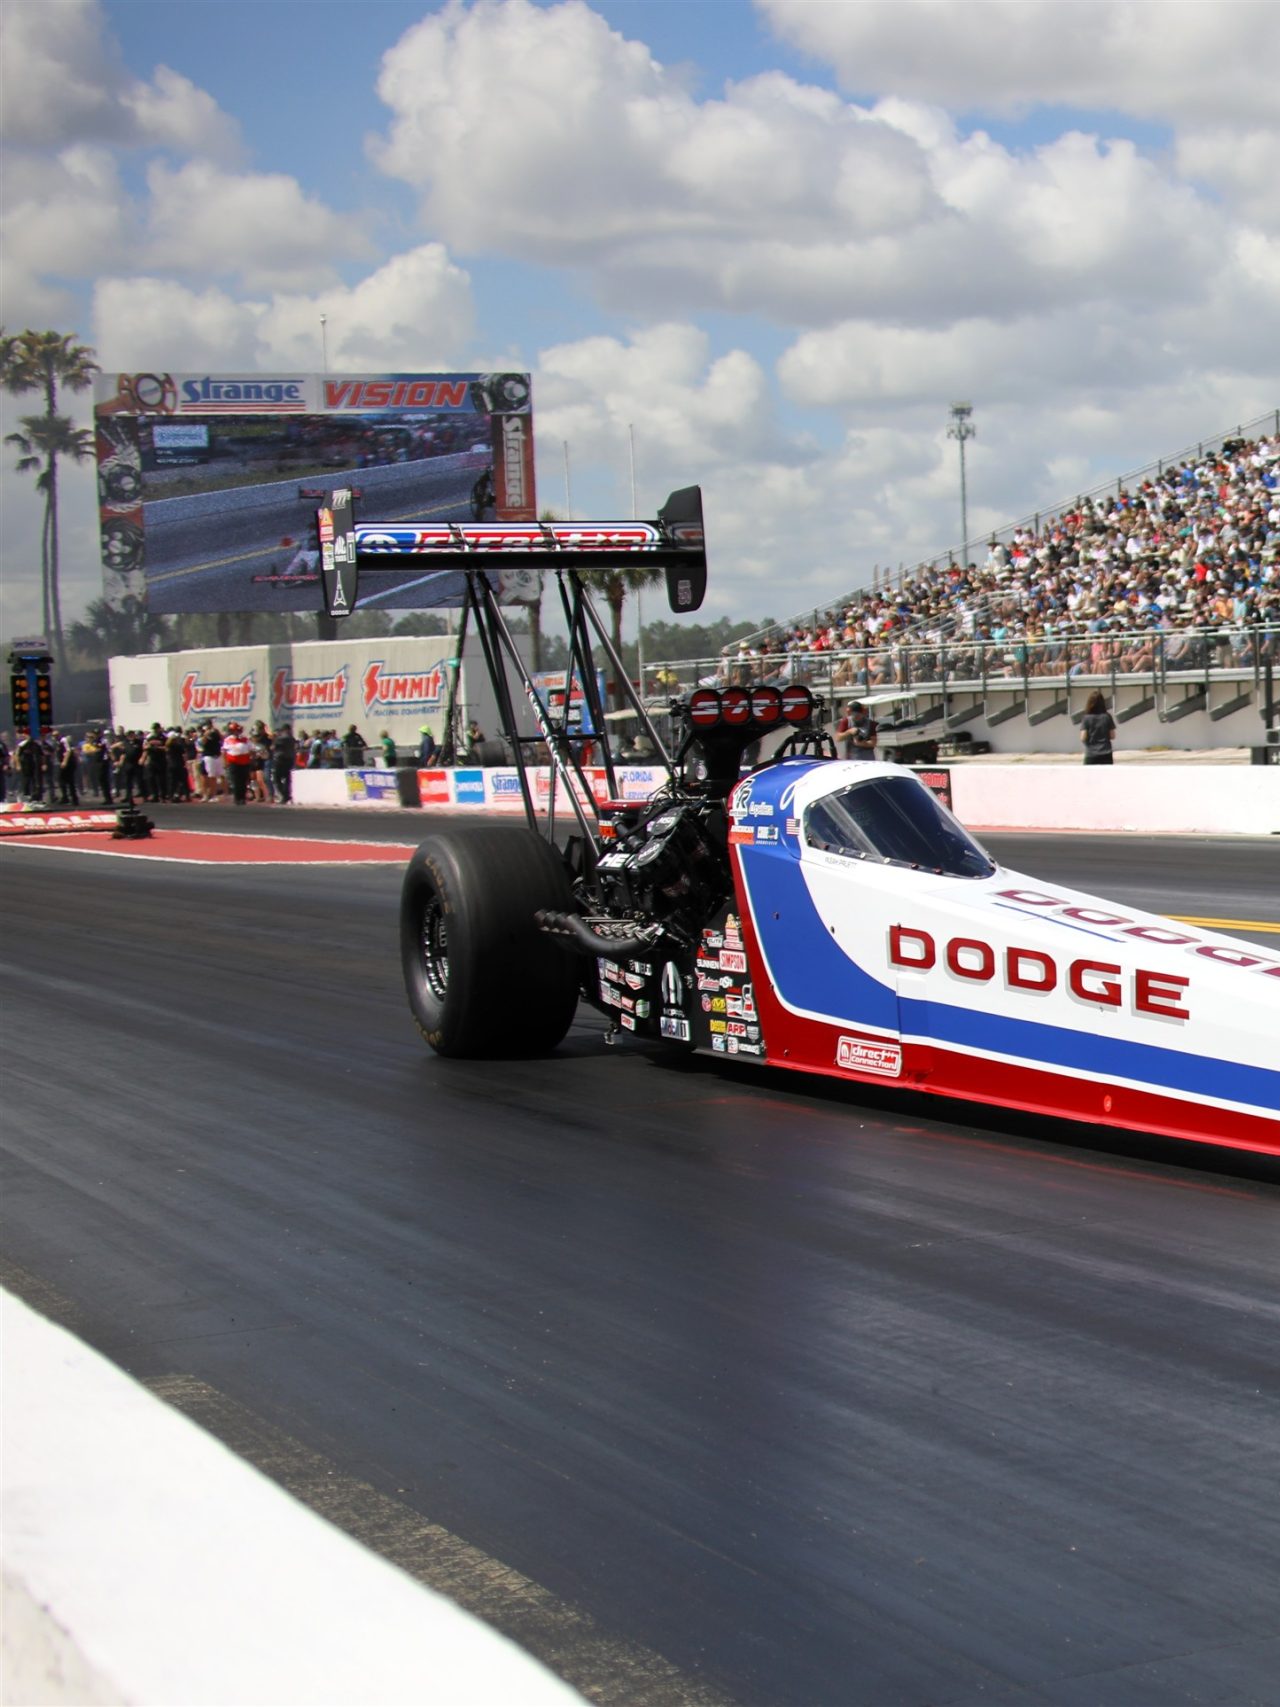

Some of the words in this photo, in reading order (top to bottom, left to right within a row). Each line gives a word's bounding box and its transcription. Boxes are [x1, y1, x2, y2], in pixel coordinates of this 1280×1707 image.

[182, 377, 299, 403] Strange
[323, 380, 468, 408] VISION
[502, 415, 526, 508] Strange
[721, 952, 745, 970] SIMPSON
[887, 925, 1190, 1024] DODGE
[727, 1023, 745, 1035] ARP
[851, 1055, 897, 1069] connection
[852, 1045, 887, 1061] direct
